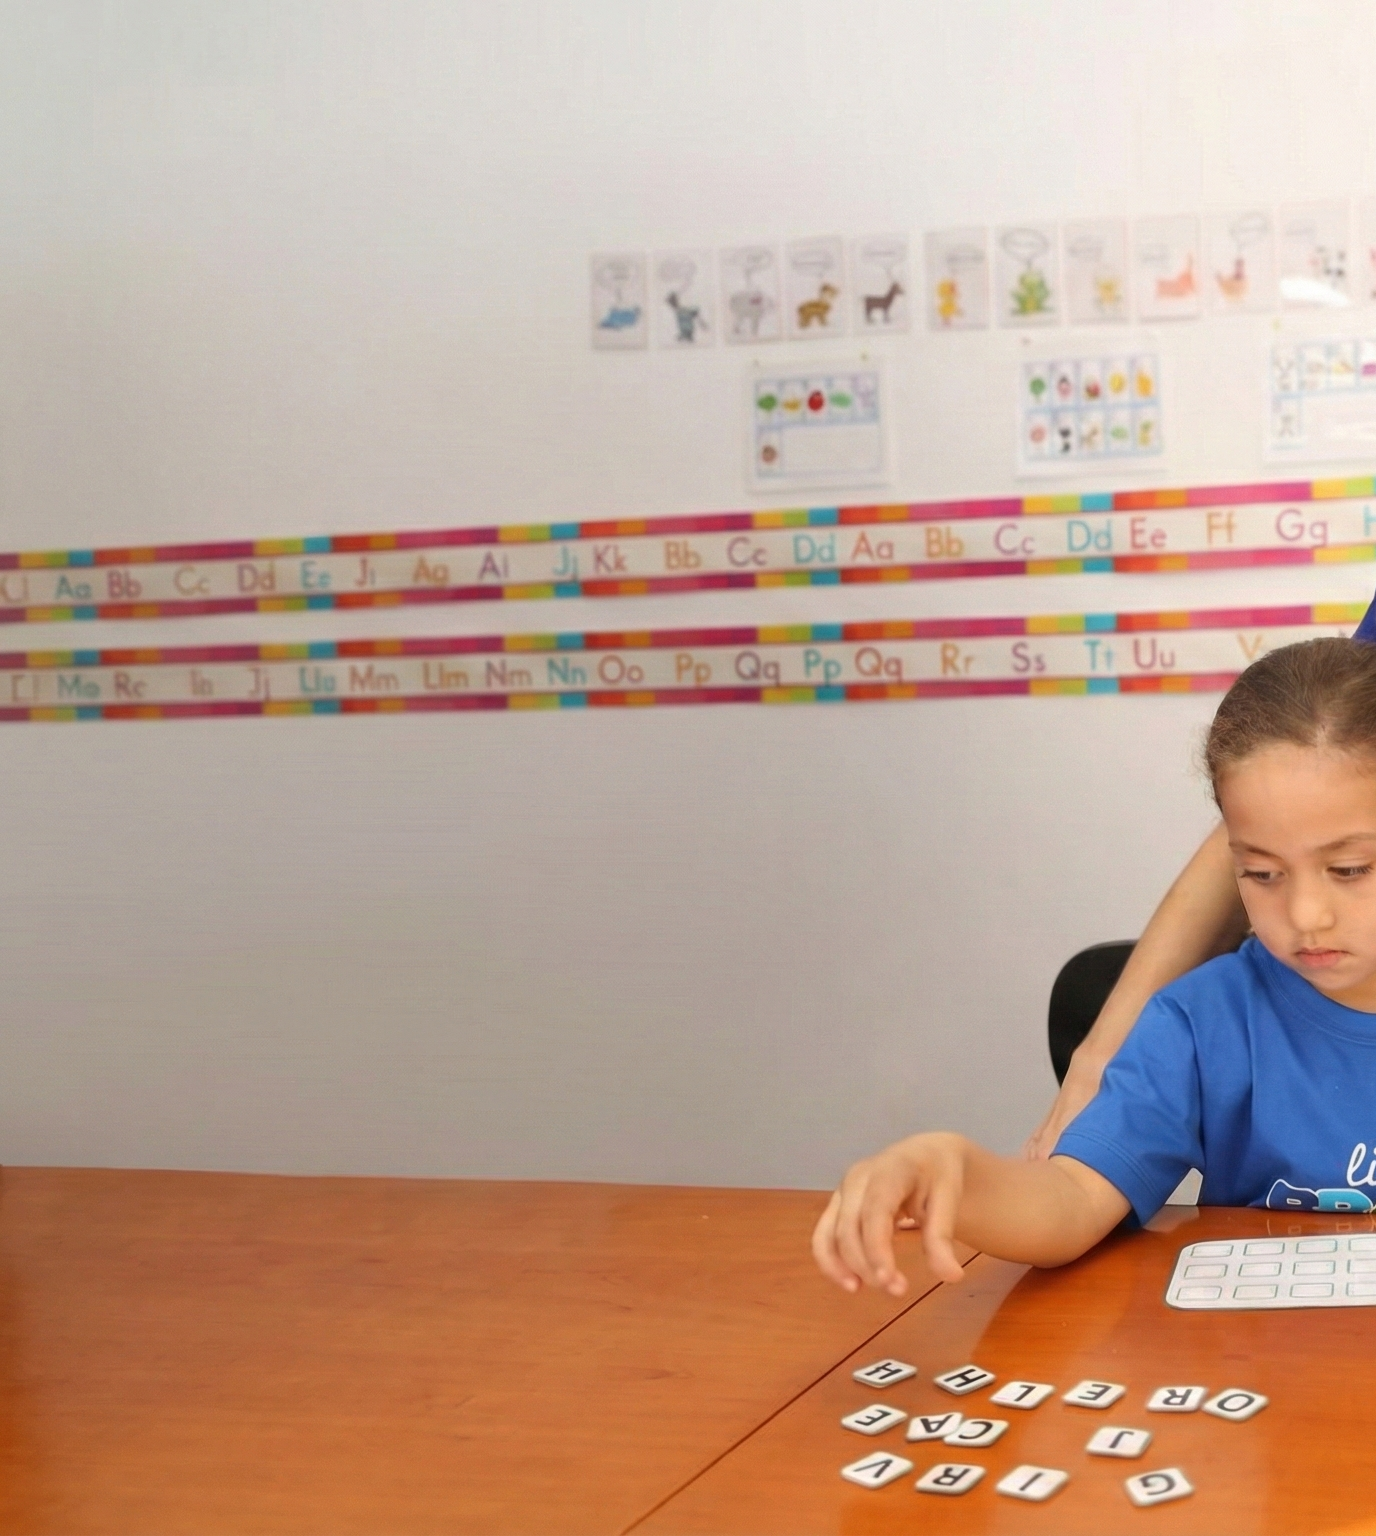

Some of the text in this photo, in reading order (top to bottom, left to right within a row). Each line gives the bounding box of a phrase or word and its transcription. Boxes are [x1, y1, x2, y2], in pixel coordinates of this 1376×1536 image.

[107, 570, 142, 599] Bb
[174, 565, 210, 596] Cc
[237, 562, 276, 593] Dd
[593, 544, 626, 573] Kk
[664, 540, 701, 570] Bb
[727, 536, 768, 567] Cc
[793, 526, 835, 563] Dd
[852, 530, 894, 560] Aa
[925, 526, 964, 558] Bb
[993, 524, 1035, 555] Cc
[1067, 519, 1112, 552] Dd
[1130, 517, 1167, 549] Ee
[1206, 512, 1236, 543] Ff
[1275, 509, 1328, 547] Gg
[547, 657, 587, 685] Nn
[598, 654, 644, 683] Oo
[675, 653, 711, 687] Pp
[735, 650, 780, 687] Qq
[804, 648, 842, 688] Pp
[855, 647, 903, 685] Qq
[940, 643, 974, 674] Rr
[1011, 642, 1046, 673] Ss
[1084, 640, 1113, 669] Tt
[1133, 638, 1175, 669] Uu
